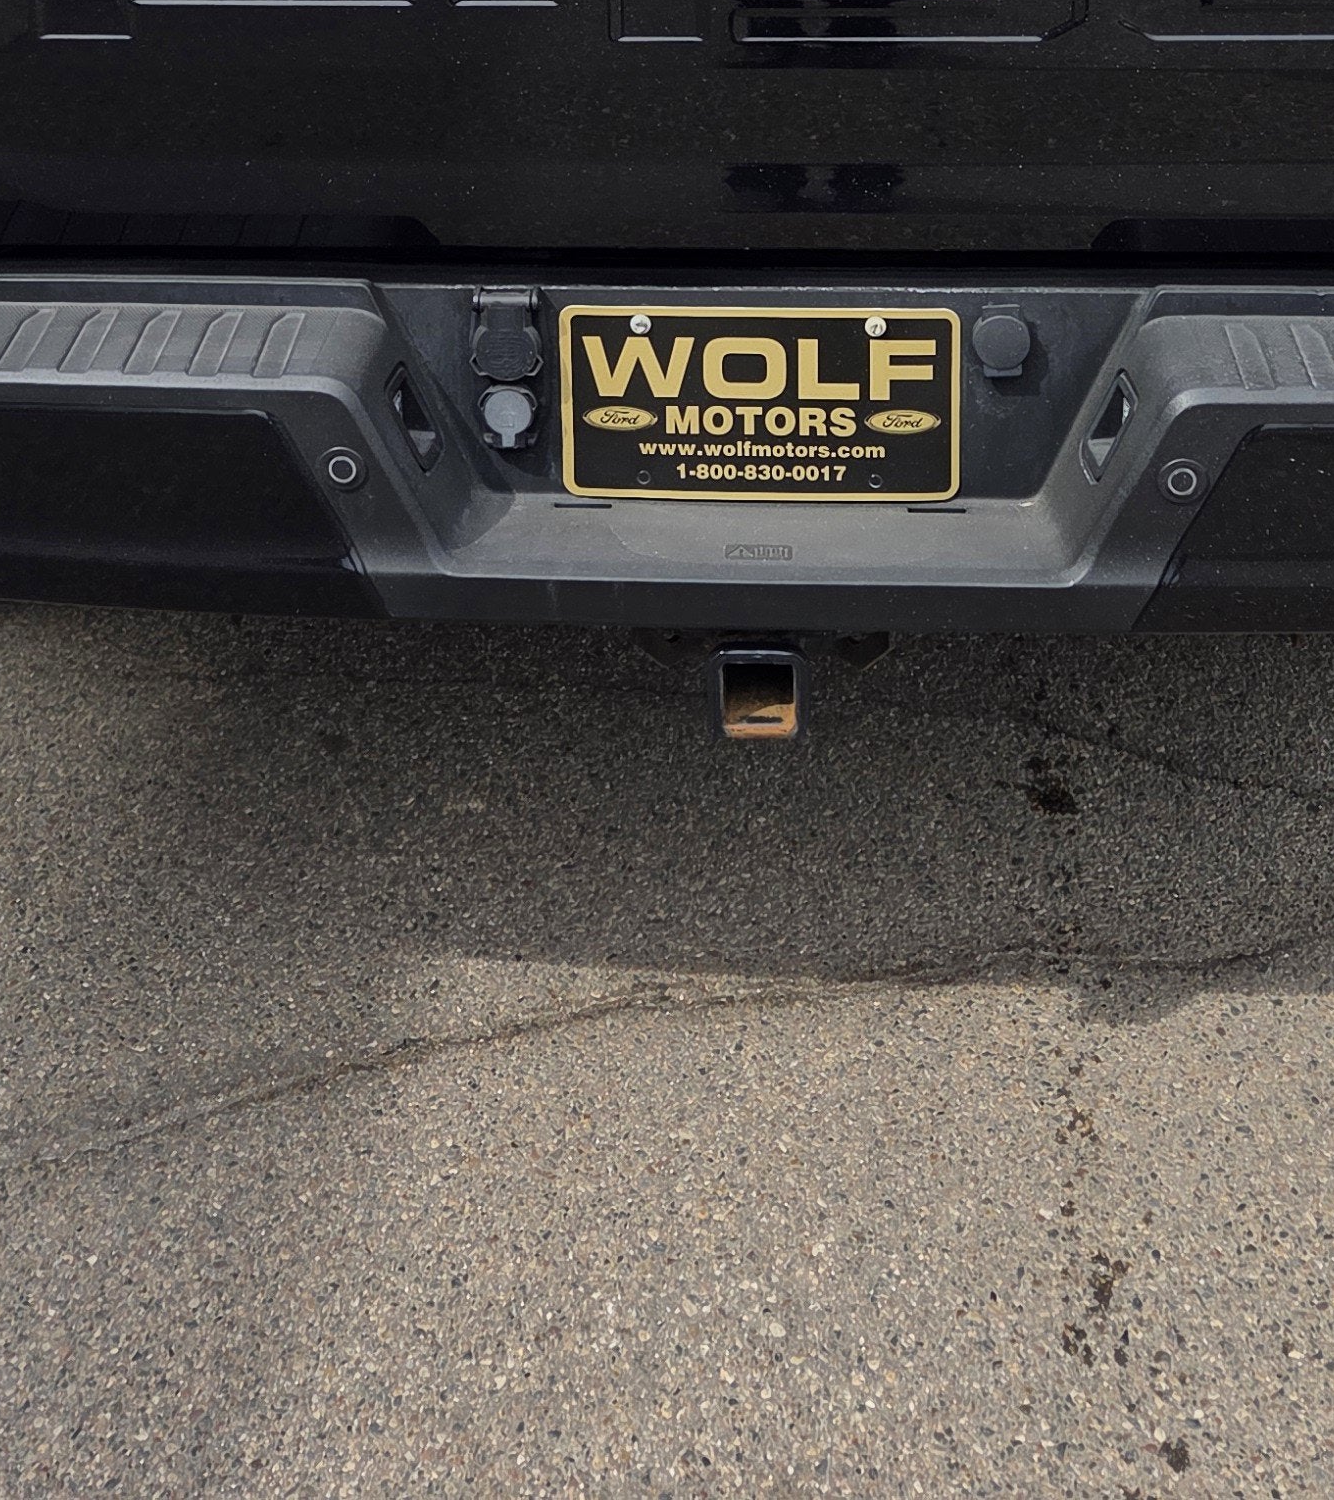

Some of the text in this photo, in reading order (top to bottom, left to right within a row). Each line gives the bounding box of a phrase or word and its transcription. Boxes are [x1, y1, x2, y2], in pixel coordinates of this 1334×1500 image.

[581, 335, 937, 401] WOLF
[599, 410, 641, 427] Ford
[665, 405, 857, 438] MOTORS
[881, 413, 923, 430] Ford
[639, 441, 886, 459] www.wolfmotors.com
[676, 463, 847, 482] 1-800-830-0017
